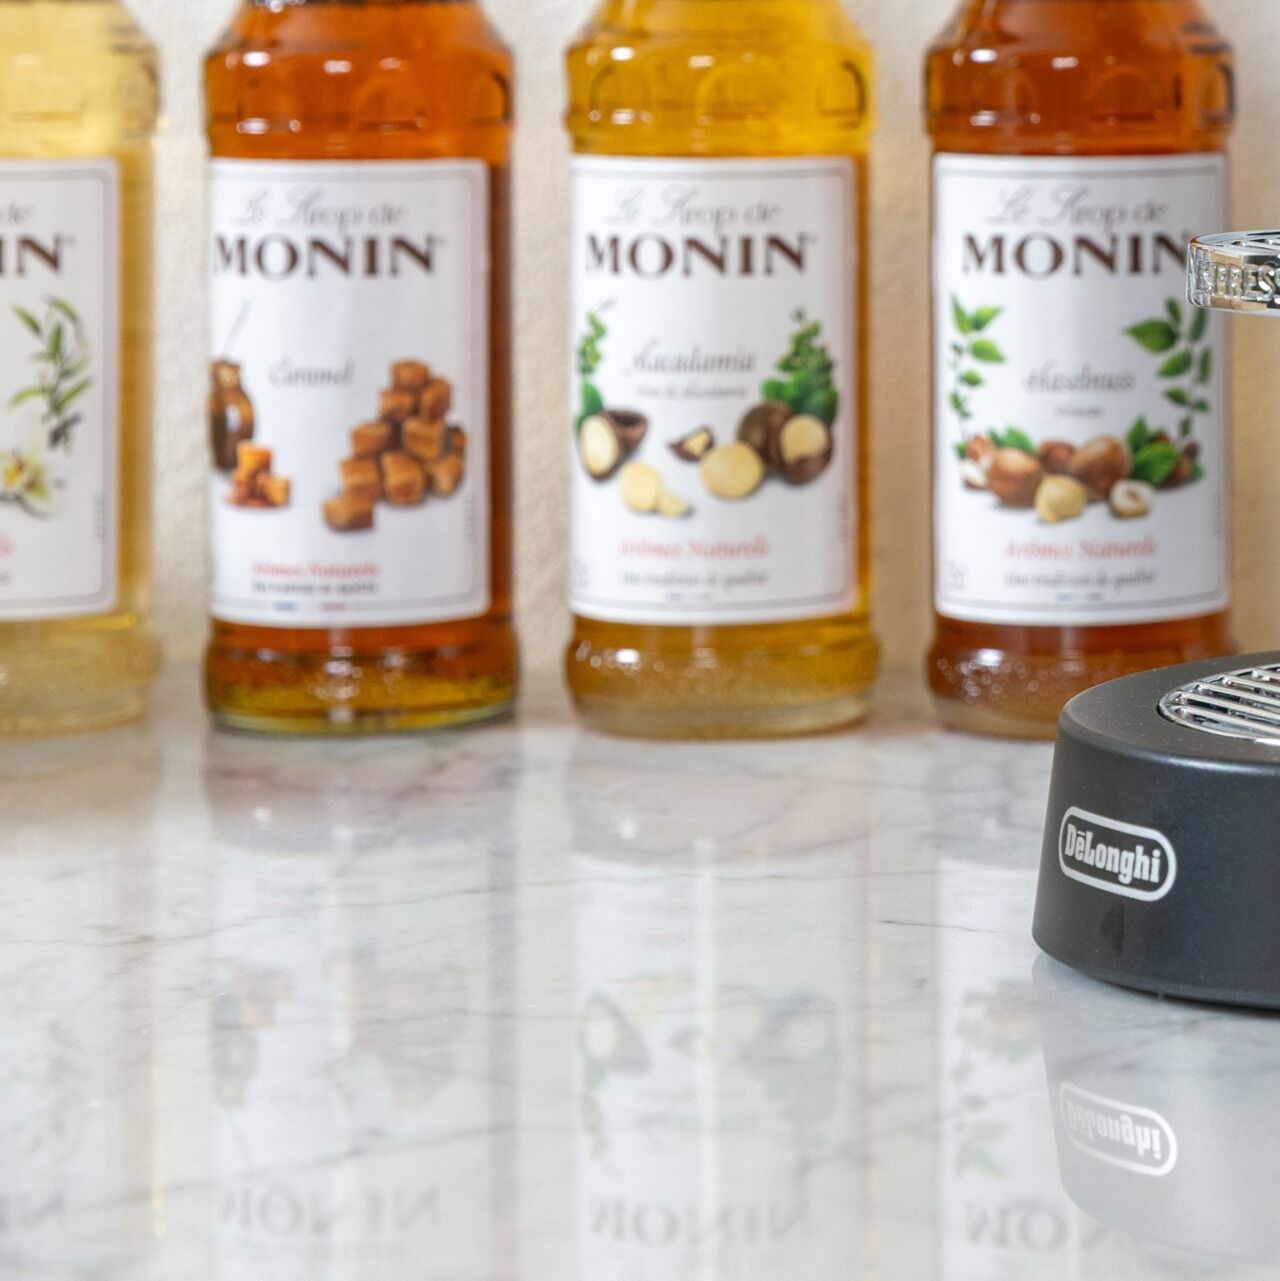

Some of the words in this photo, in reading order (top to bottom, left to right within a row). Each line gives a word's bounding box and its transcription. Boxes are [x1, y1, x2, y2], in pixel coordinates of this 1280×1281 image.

[213, 232, 436, 282] MONIN
[583, 231, 808, 281] MONIN
[962, 231, 1188, 280] MONIN
